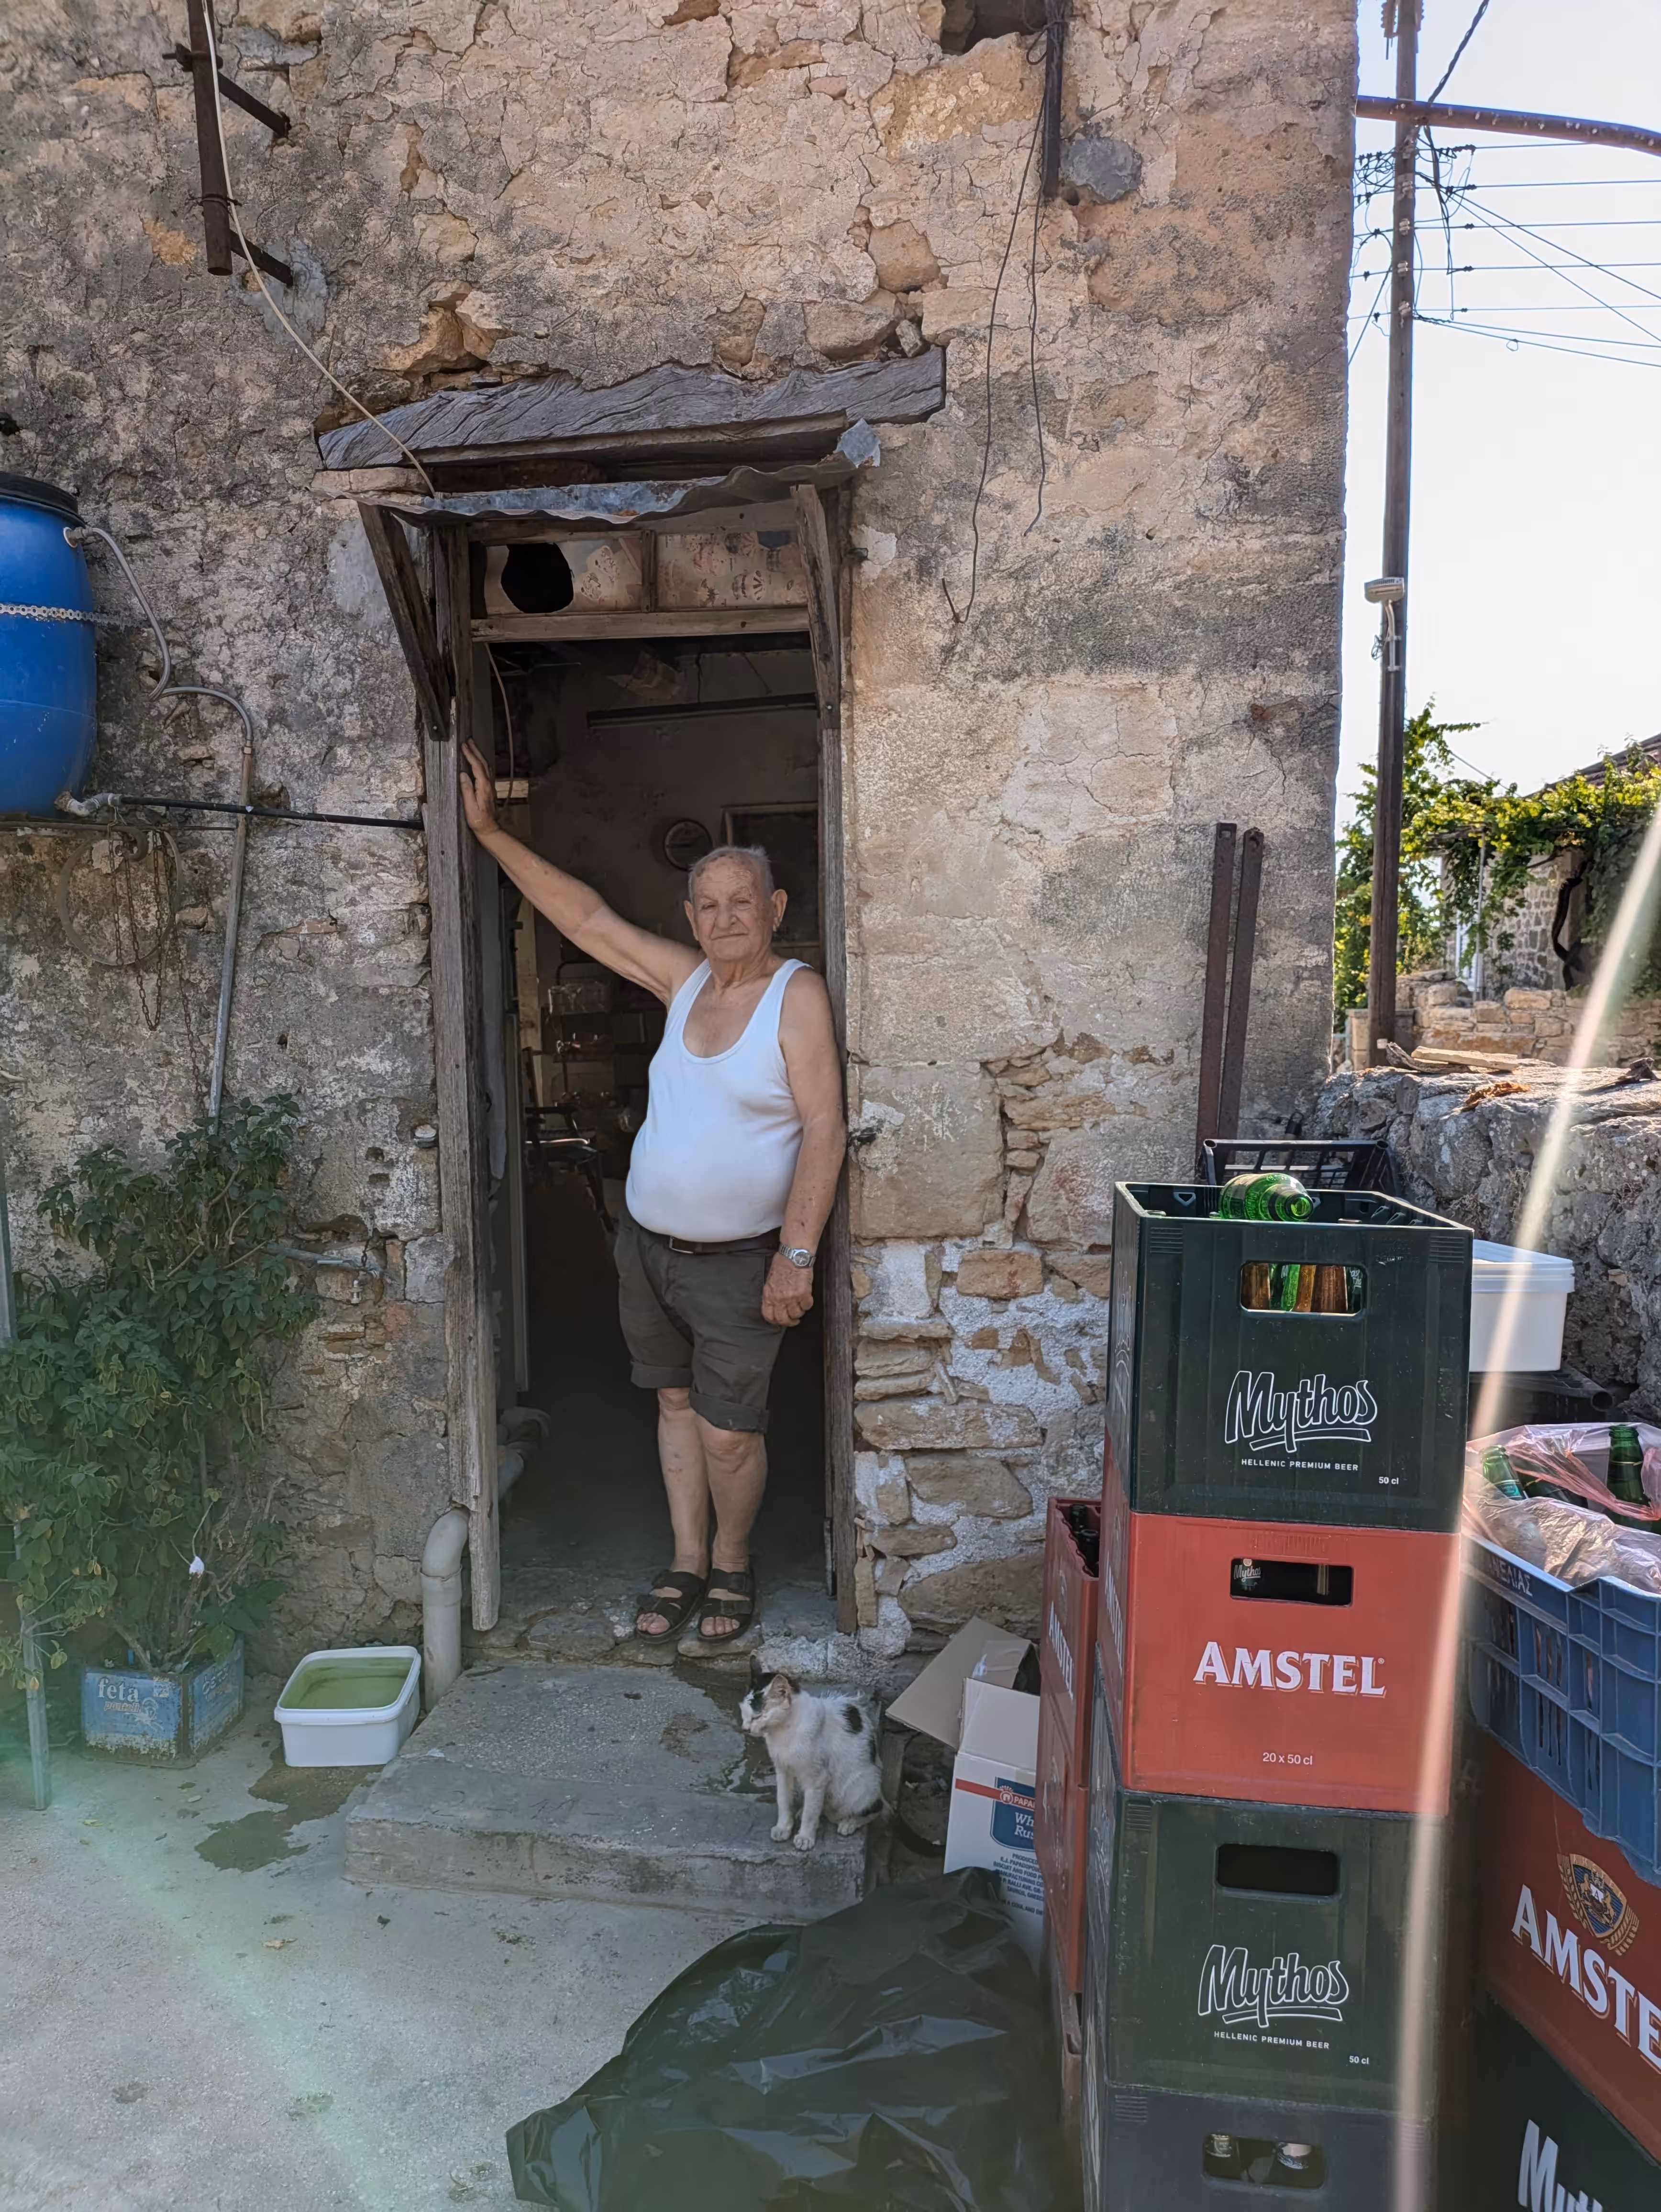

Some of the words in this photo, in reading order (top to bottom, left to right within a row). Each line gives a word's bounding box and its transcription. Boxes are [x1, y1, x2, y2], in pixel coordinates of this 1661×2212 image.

[1225, 1370, 1378, 1453] Mythos
[1241, 1459, 1286, 1468] HELLENIC
[1289, 1460, 1331, 1470] PREMIUM
[1334, 1463, 1359, 1471] BEER
[1378, 1476, 1389, 1484] 50
[1391, 1477, 1399, 1485] cl
[1233, 1564, 1262, 1582] Mythos
[1193, 1641, 1386, 1698] AMSTEL
[97, 1677, 139, 1702] feta
[1262, 1752, 1276, 1762] 20
[1278, 1755, 1285, 1763] x
[1287, 1754, 1301, 1764] 50
[1303, 1755, 1313, 1765] cl
[1012, 1866, 1023, 1875] AND
[1198, 1944, 1350, 2028] Mythos
[1214, 2031, 1258, 2042] HELLENIC
[1261, 2035, 1302, 2047] PREMIUM
[1306, 2040, 1330, 2049] BEER
[1349, 2056, 1360, 2064] 50
[1362, 2057, 1370, 2065] cl
